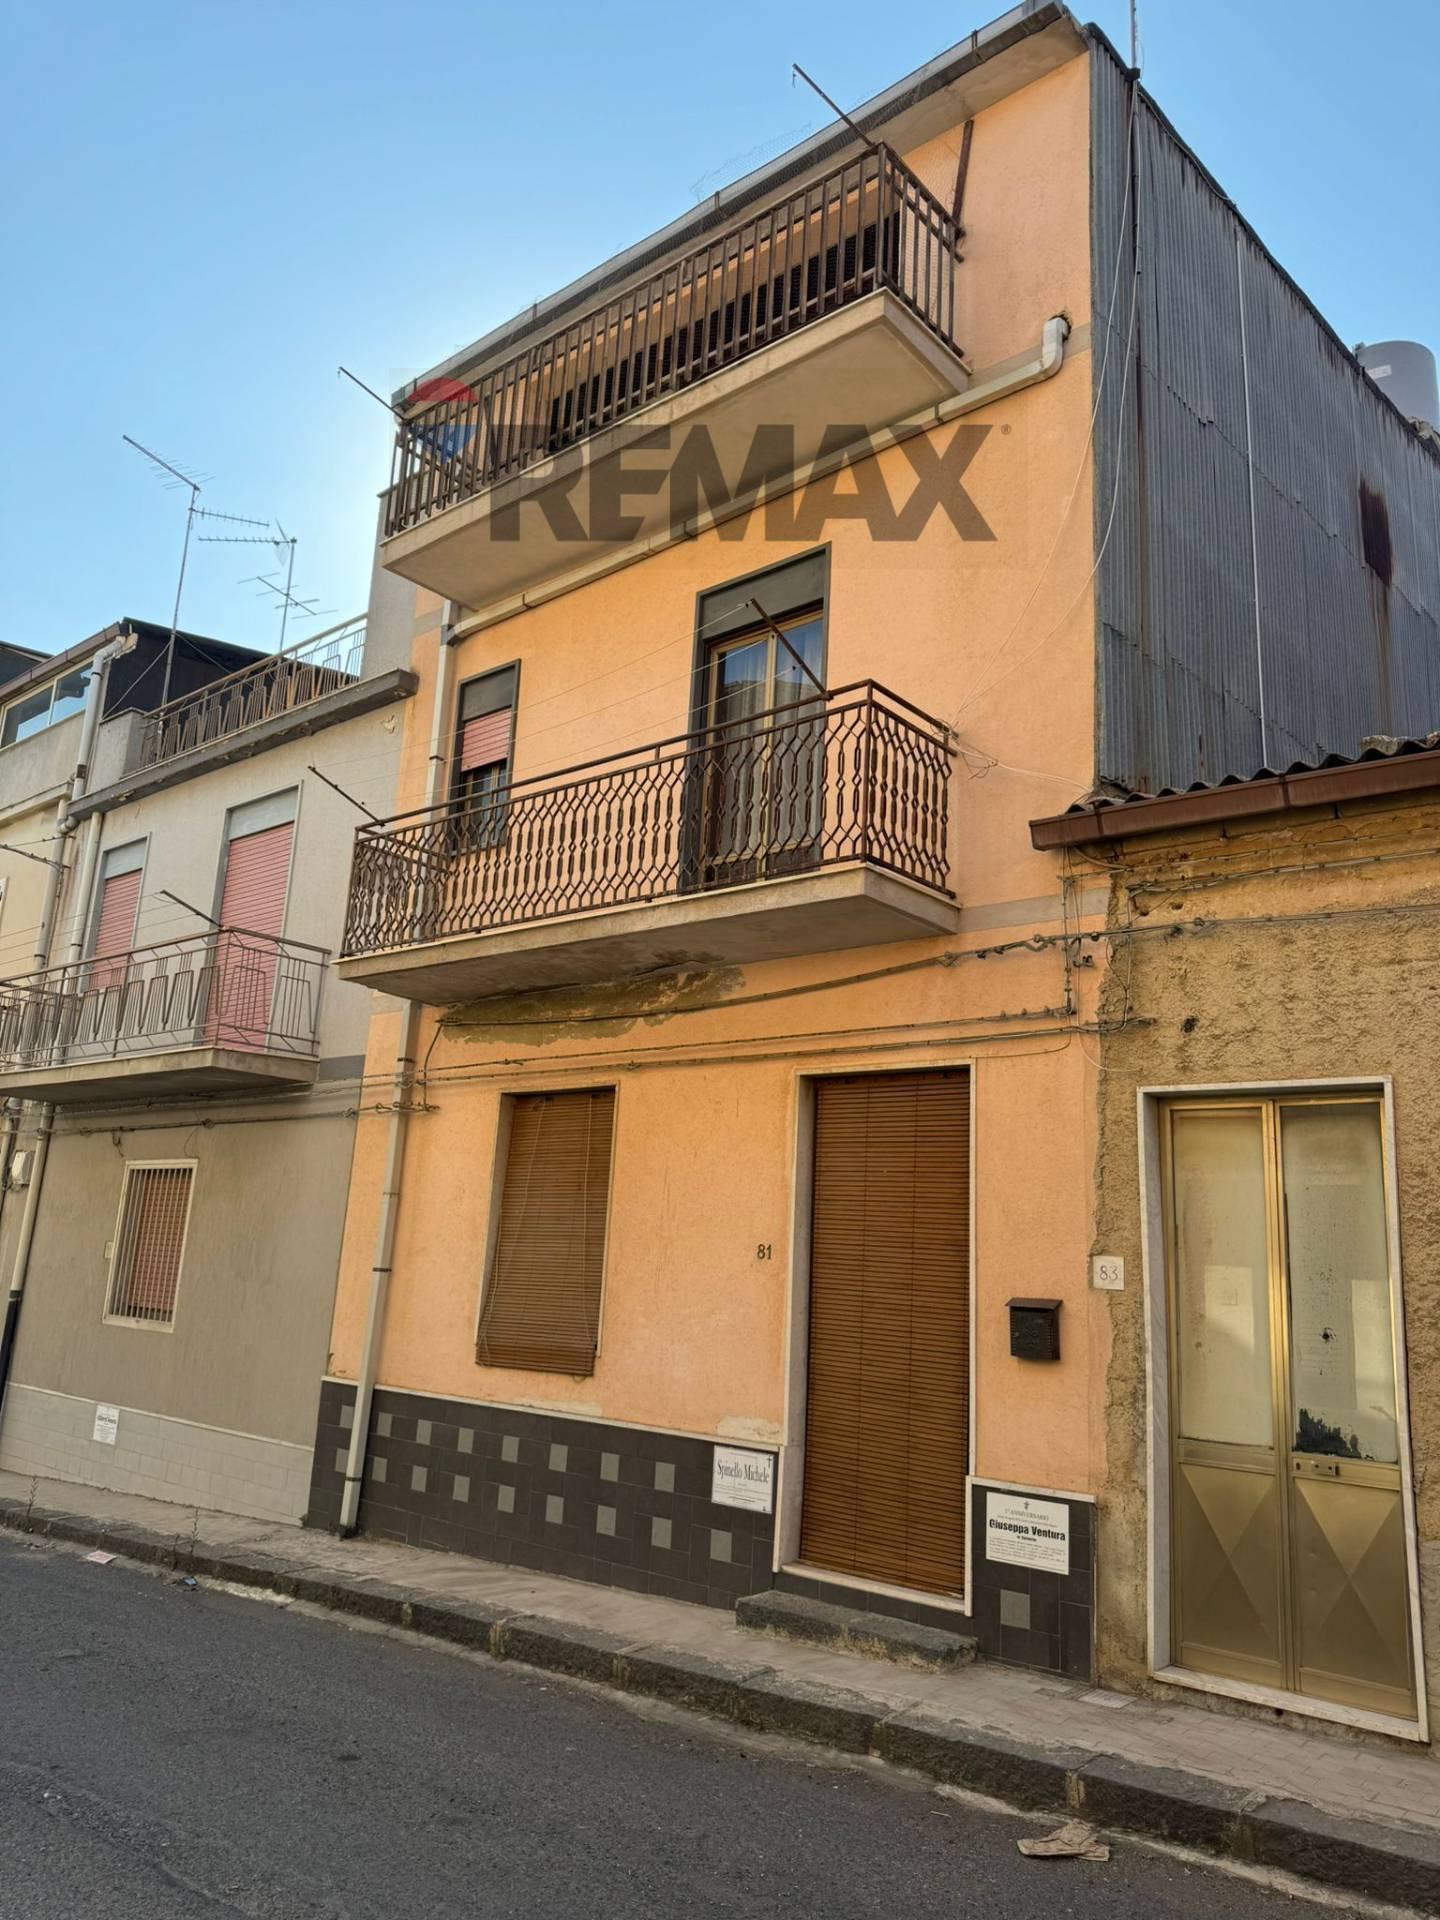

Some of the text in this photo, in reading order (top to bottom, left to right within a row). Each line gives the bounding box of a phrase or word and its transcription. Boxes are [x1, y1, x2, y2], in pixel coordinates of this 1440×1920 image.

[757, 1243, 772, 1260] 81
[1099, 1265, 1118, 1281] 83
[743, 1464, 770, 1483] Michele
[989, 1518, 1030, 1534] Giuseppa
[1031, 1525, 1066, 1540] Ventura
